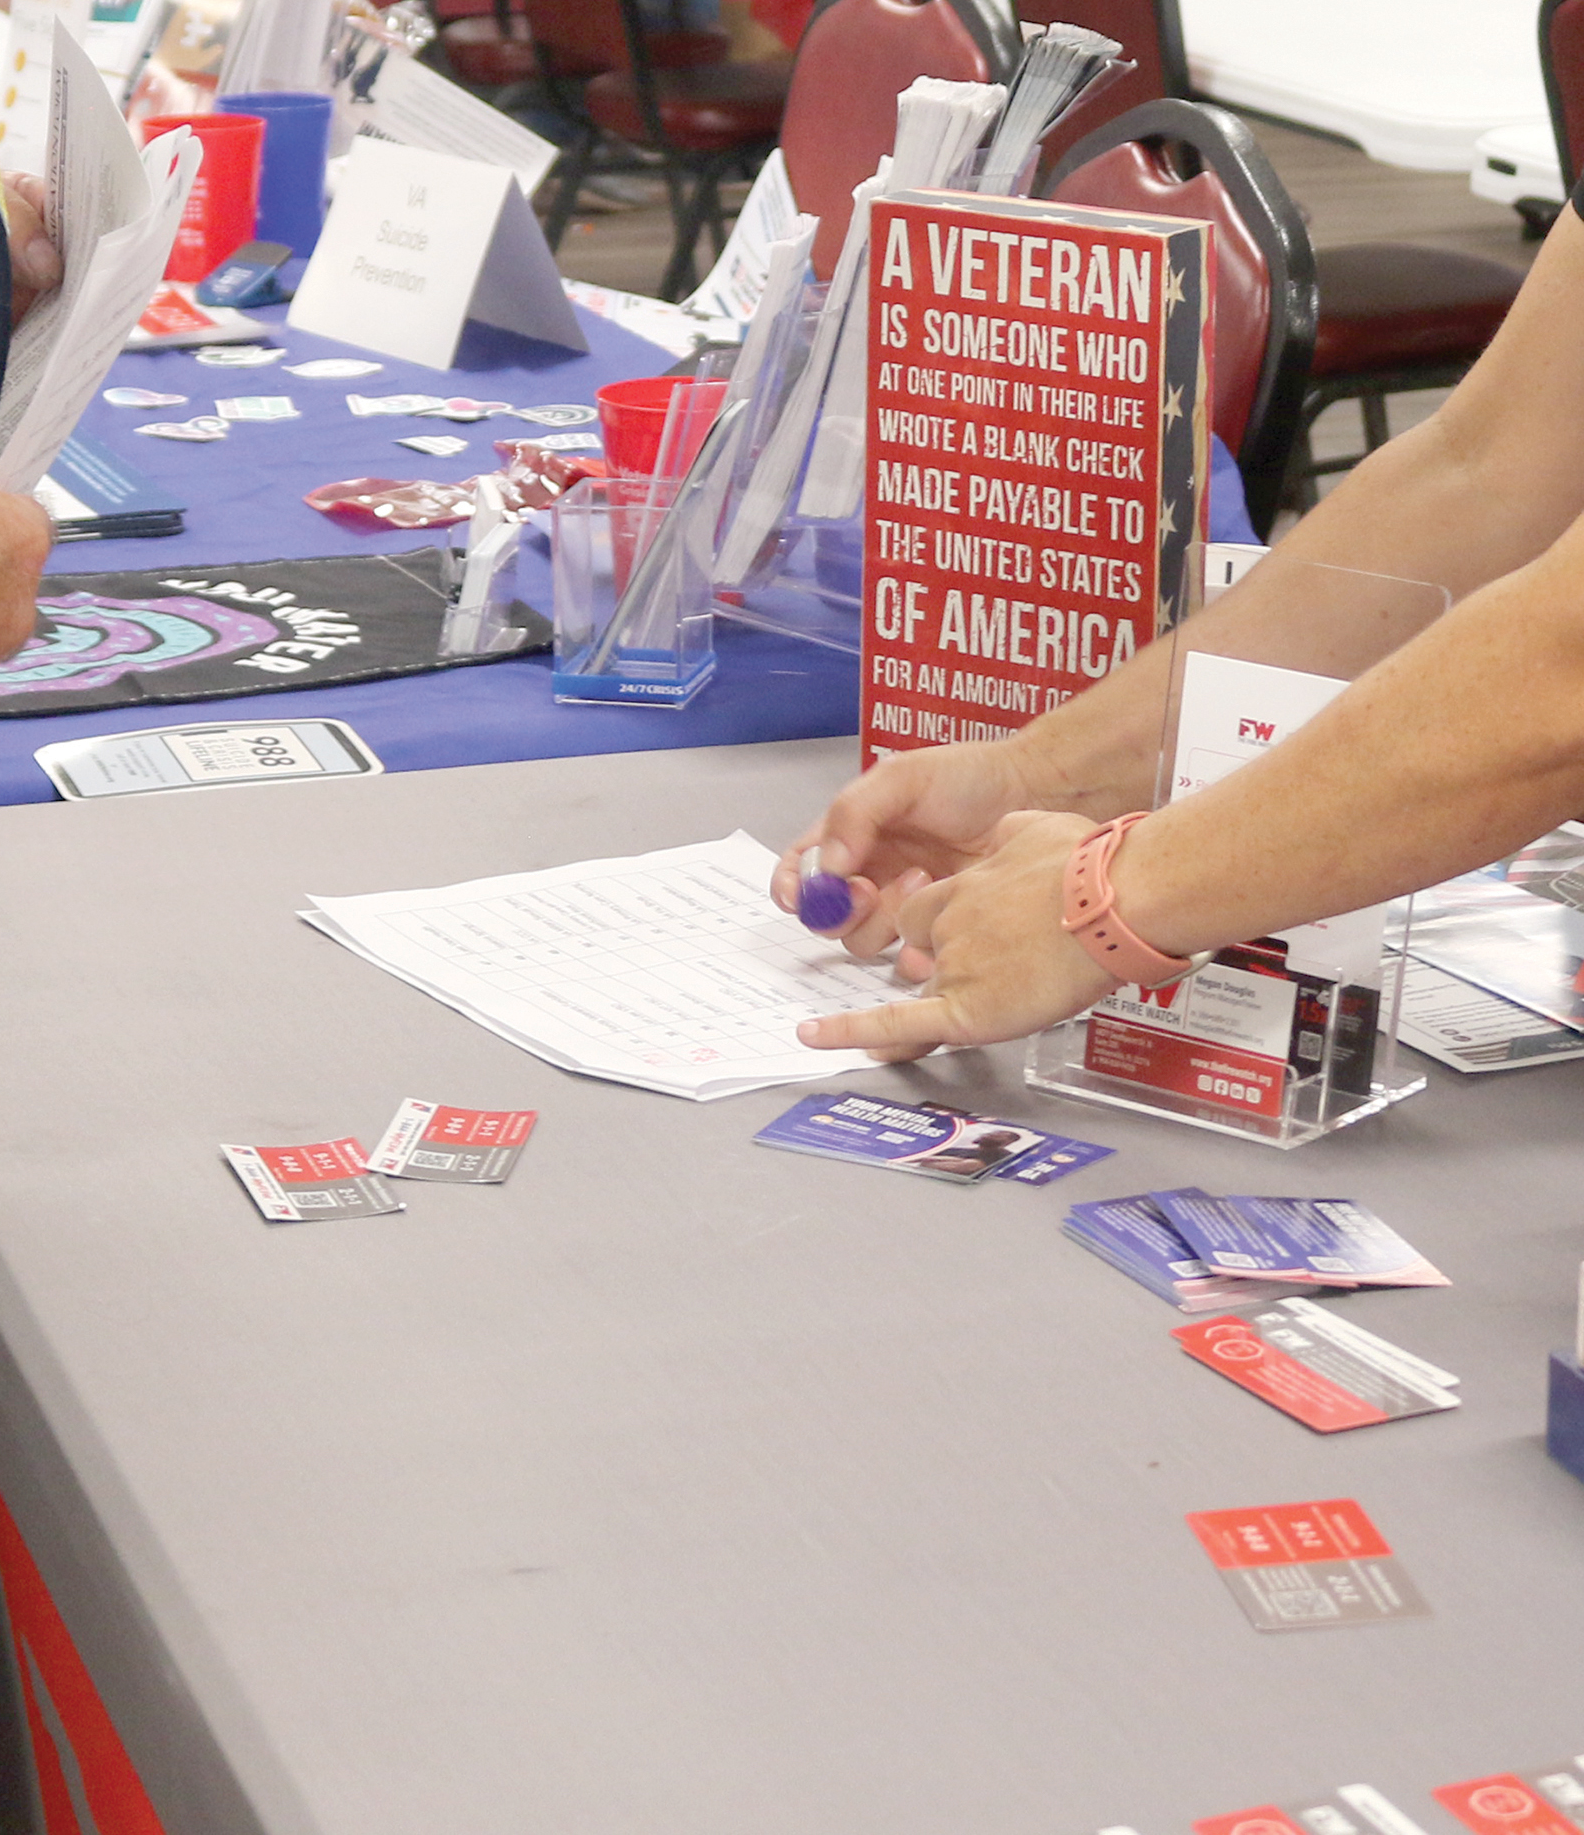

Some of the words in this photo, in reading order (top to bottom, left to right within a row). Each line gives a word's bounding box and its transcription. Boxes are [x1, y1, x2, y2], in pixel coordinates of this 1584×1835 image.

[407, 184, 427, 208] VA
[376, 219, 429, 252] Suicide
[351, 255, 427, 294] Prevention
[882, 218, 913, 290] A
[928, 223, 1152, 324] VETERAN
[880, 302, 909, 349] IS
[923, 308, 1068, 373] SOMEONE
[1076, 330, 1149, 384] WHO
[878, 362, 903, 391] AT
[907, 366, 946, 399] ONE
[950, 372, 1009, 408] POINT
[1013, 382, 1033, 413] IN
[1038, 385, 1097, 422] THEIR
[1102, 395, 1145, 429] LIFE
[877, 407, 956, 453] WROTE
[961, 422, 977, 456] A
[983, 425, 1060, 469] BLANK
[1066, 438, 1145, 482] CHECK
[877, 459, 961, 515] MADE
[969, 474, 1098, 538] PAYABLE
[1105, 497, 1145, 544] TO
[876, 519, 927, 565] THE
[935, 529, 1033, 584] UNITED
[1040, 548, 1142, 602] STATES
[875, 577, 929, 644] OF
[938, 589, 1137, 679] AMERICA
[619, 682, 646, 695] 24/7
[646, 684, 683, 697] CRISIS
[873, 655, 912, 691] FOR
[917, 664, 946, 698] AN
[951, 670, 1040, 714] AMOUNT
[871, 702, 912, 736] AND
[1238, 717, 1277, 742] FW
[184, 739, 219, 773] LIFELINE
[206, 745, 238, 772] CRISIS
[218, 736, 255, 770] SUICIDE
[240, 735, 295, 768] 988
[1223, 980, 1257, 998] Douglas
[1121, 1001, 1143, 1017] FIRE
[1146, 1007, 1182, 1026] WATCH
[826, 1104, 886, 1124] HEALTH
[878, 1114, 948, 1140] MATTERS
[842, 1096, 885, 1116] YOUR
[882, 1105, 938, 1127] MENTAL
